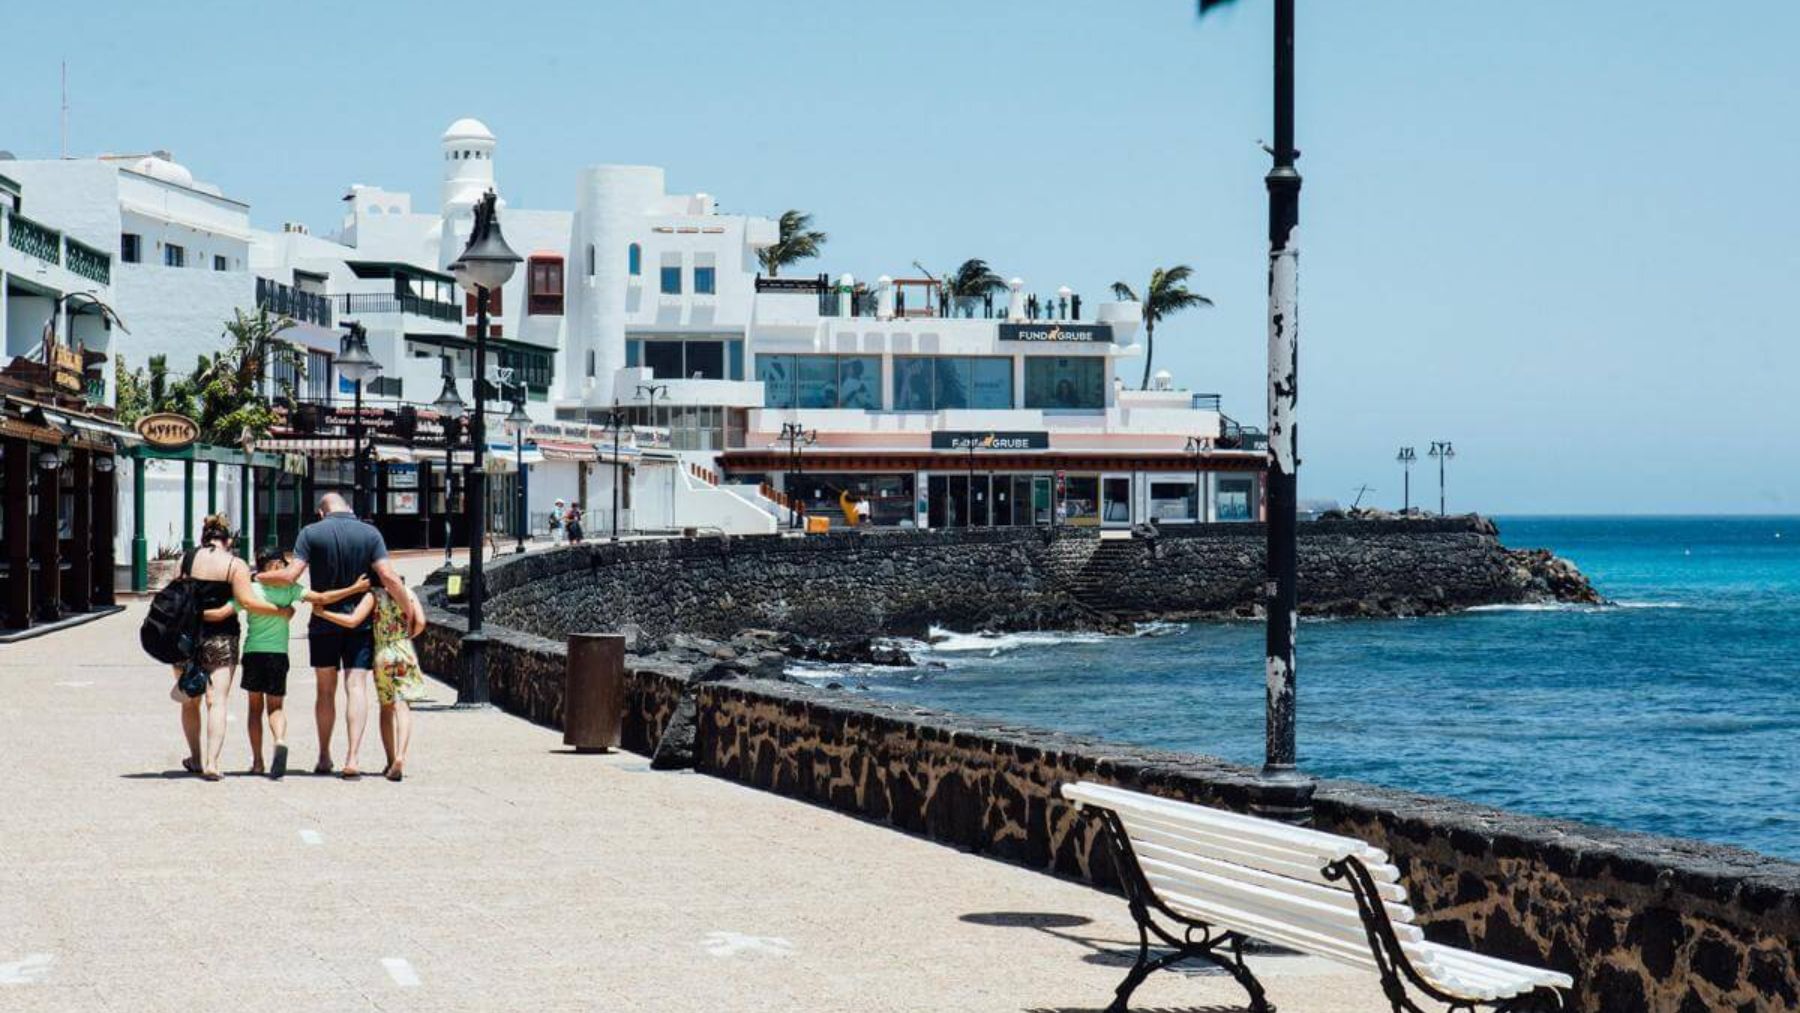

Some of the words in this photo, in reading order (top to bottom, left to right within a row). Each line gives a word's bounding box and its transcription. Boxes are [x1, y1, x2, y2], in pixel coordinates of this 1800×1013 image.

[1019, 331, 1048, 341] FUND
[1057, 331, 1093, 341] GRUBE
[147, 422, 191, 440] MYSTIC
[992, 438, 1030, 448] GRUBE
